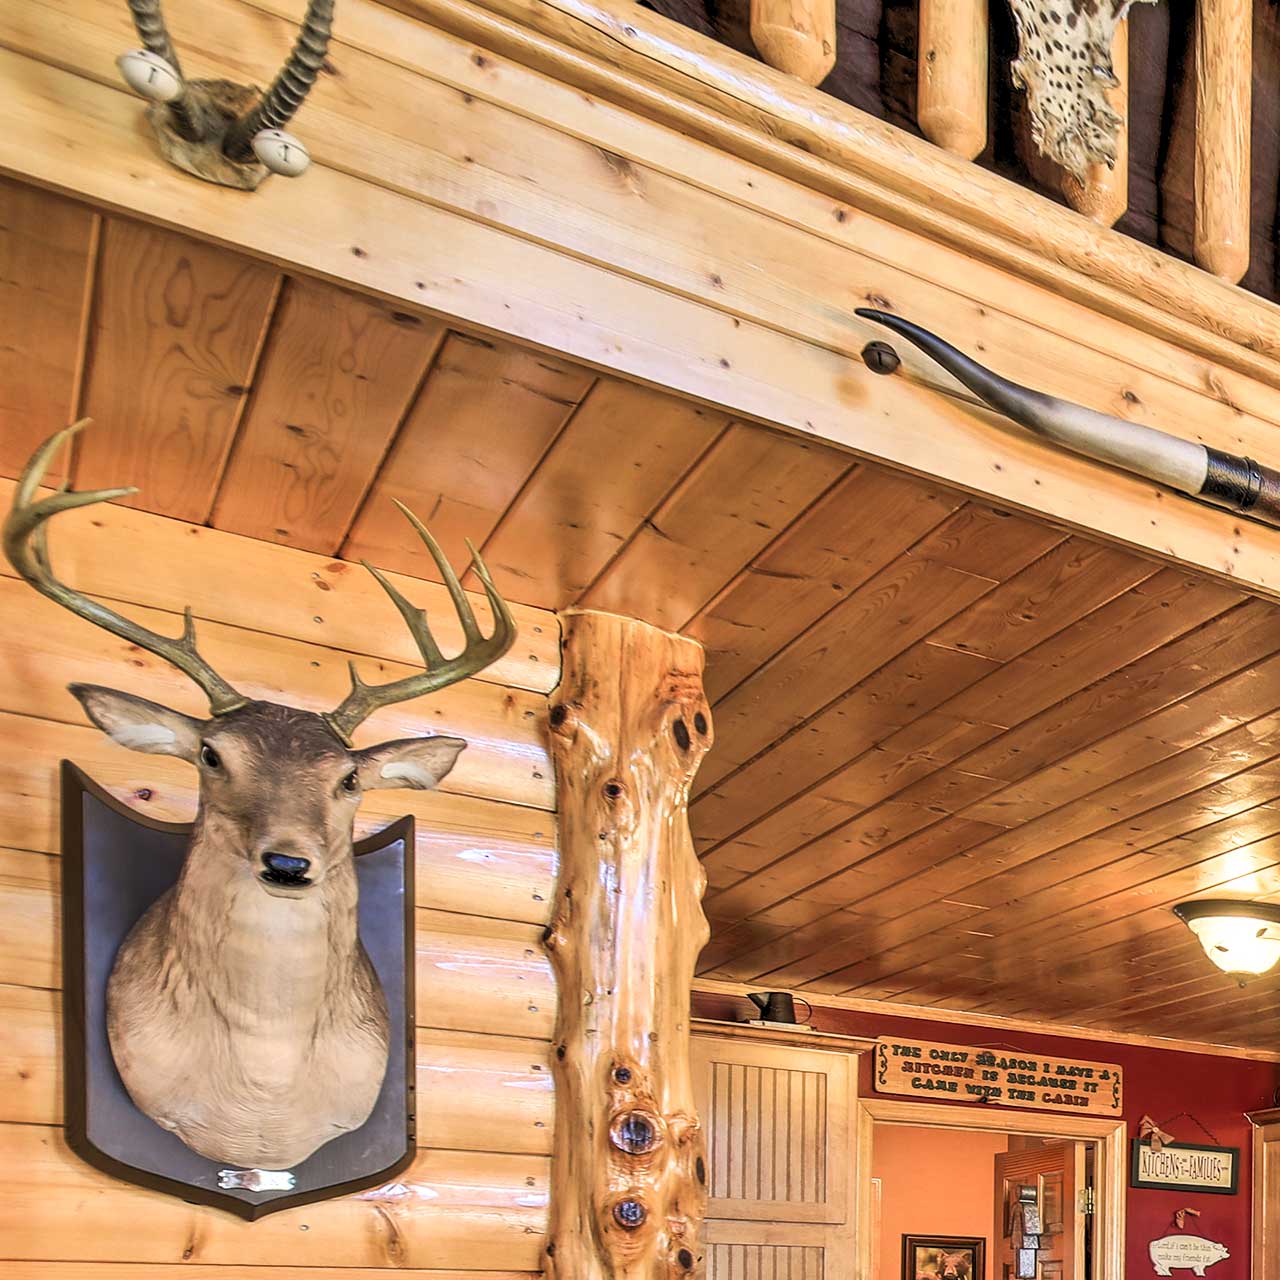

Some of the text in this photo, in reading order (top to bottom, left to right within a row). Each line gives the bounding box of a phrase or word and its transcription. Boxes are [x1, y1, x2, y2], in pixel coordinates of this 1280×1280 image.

[892, 1044, 1110, 1080] THE ONLY REASON I HAVE A
[901, 1061, 1099, 1093] KITCHEN IS BECAUSE IT
[911, 1077, 1089, 1107] CAME WITH THE CABIN
[1142, 1150, 1180, 1179] KITCHENS
[1189, 1155, 1222, 1181] FAMILIES
